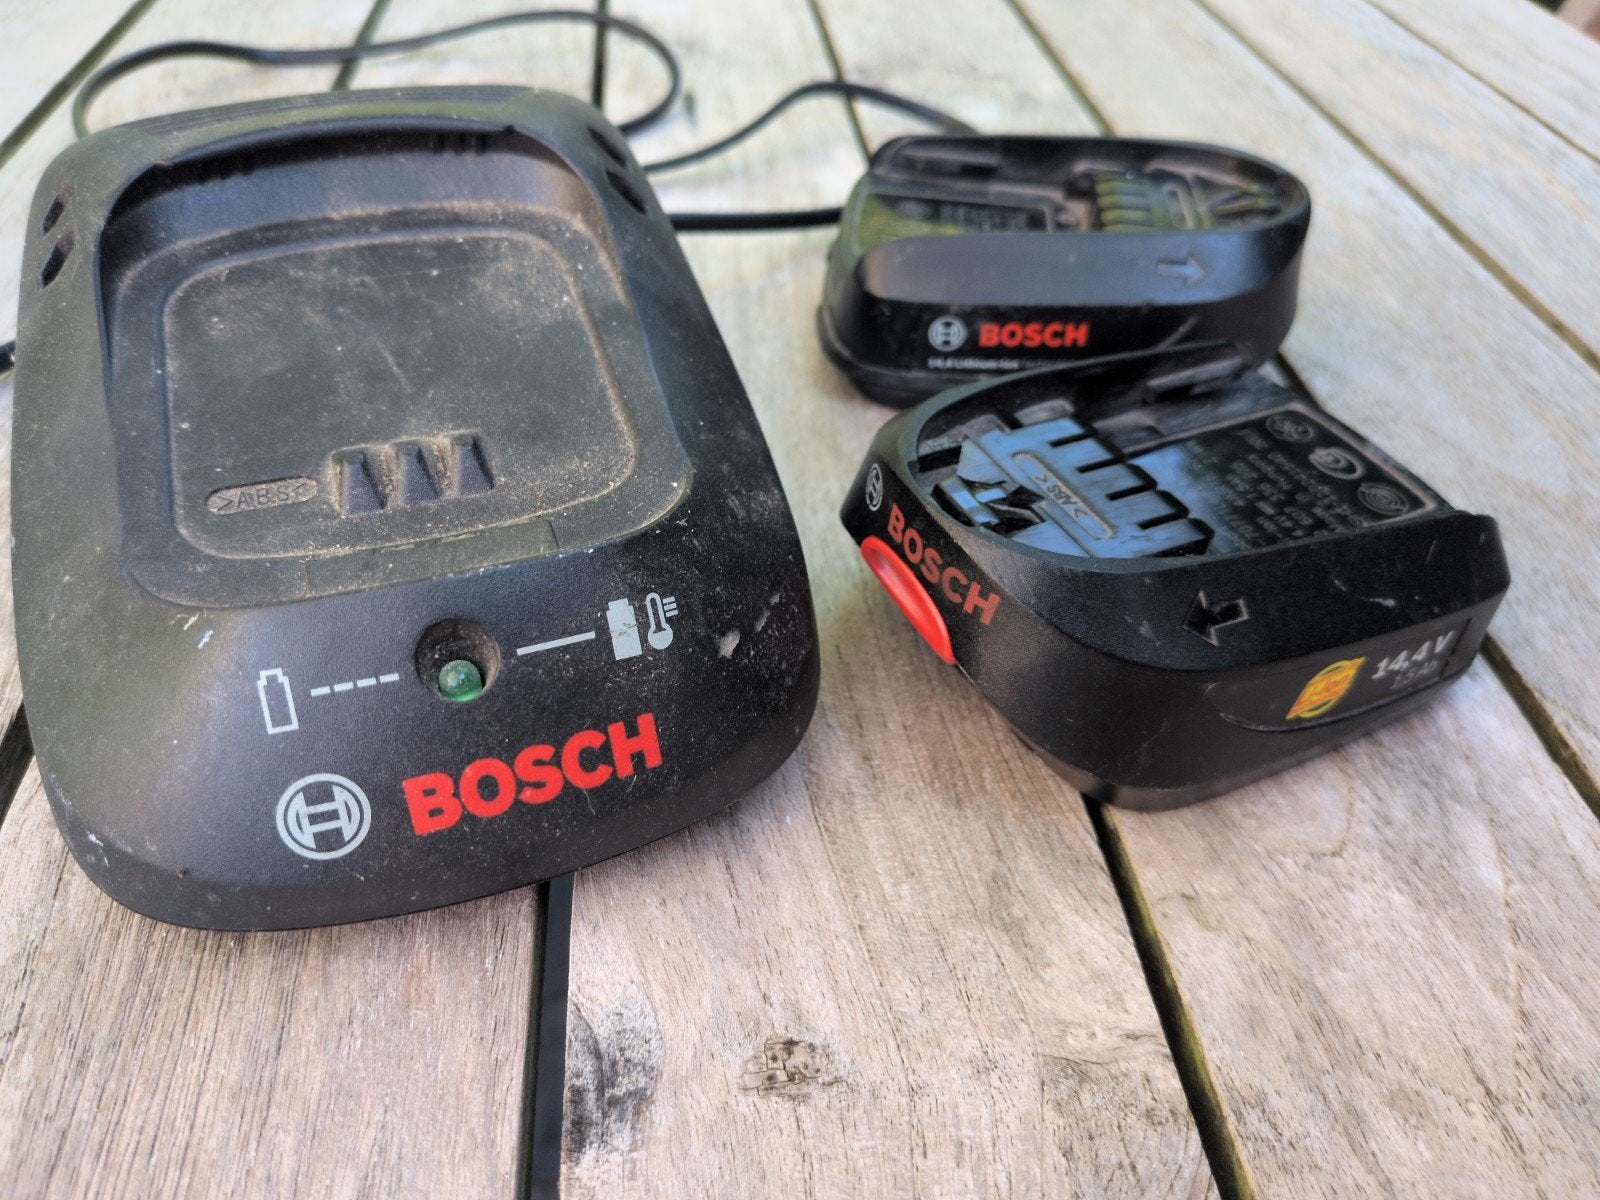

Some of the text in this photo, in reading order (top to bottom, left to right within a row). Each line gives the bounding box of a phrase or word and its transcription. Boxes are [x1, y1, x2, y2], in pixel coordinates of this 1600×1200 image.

[979, 322, 1090, 348] BOSCH
[887, 503, 1000, 625] BOSCH
[404, 713, 663, 836] BOSCH
